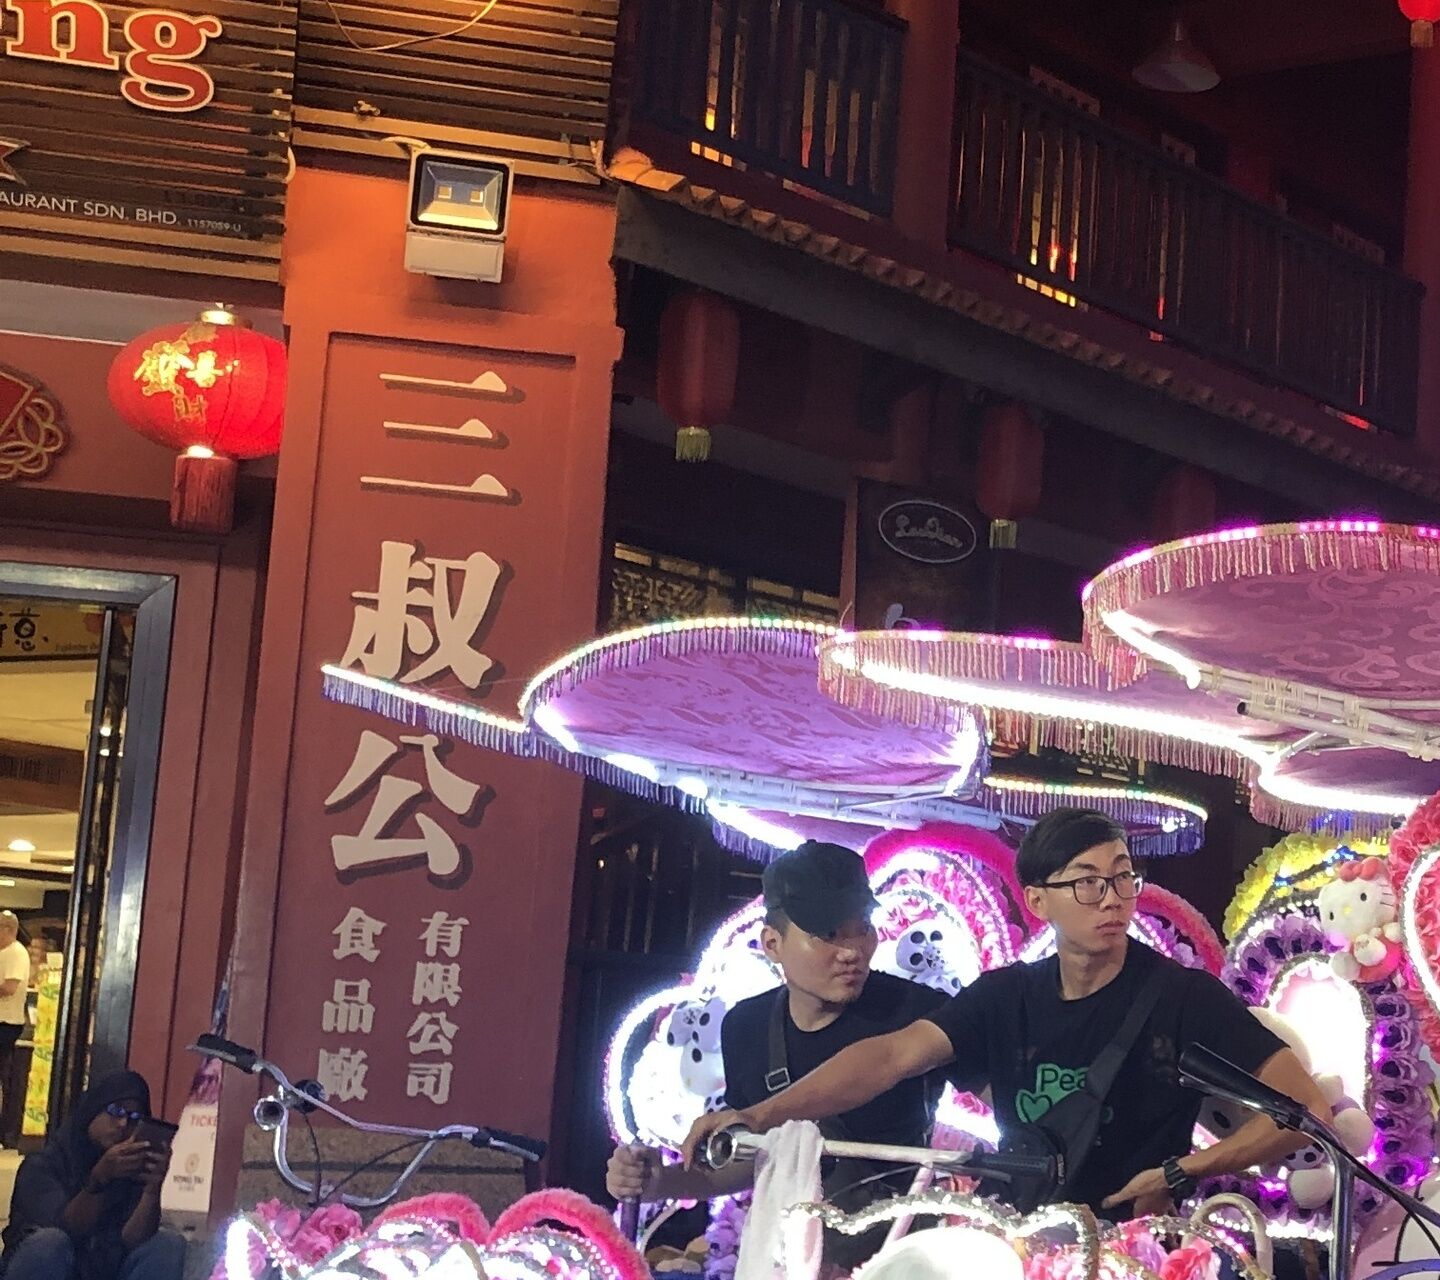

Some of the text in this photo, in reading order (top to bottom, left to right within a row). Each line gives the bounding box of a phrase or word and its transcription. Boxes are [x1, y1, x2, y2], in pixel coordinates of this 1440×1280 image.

[0, 191, 78, 213] AURANT
[84, 201, 129, 220] SDN.
[136, 208, 181, 225] BHD.
[324, 370, 507, 875] 三叔公
[317, 906, 387, 1103] 食品廠
[406, 911, 470, 1105] 有限公司
